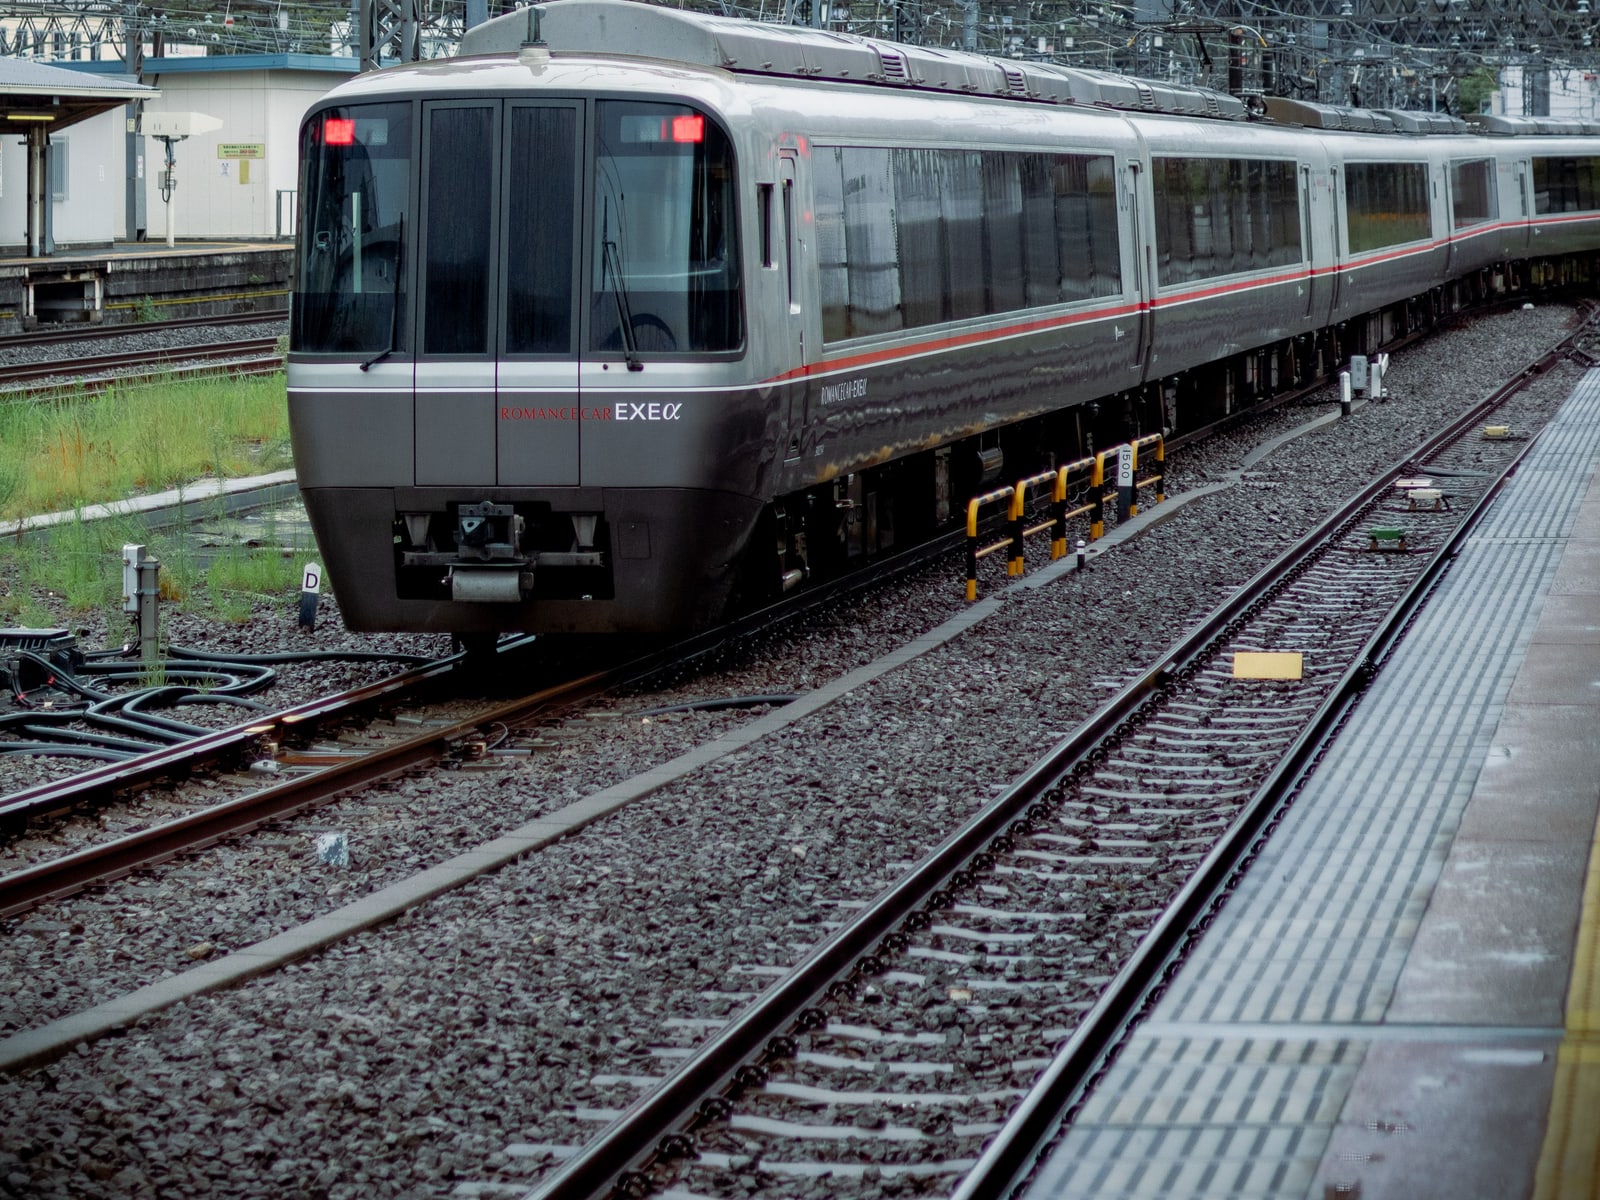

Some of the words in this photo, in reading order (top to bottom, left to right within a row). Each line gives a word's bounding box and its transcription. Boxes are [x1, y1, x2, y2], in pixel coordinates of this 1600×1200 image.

[501, 407, 612, 421] ROMANCECAR
[615, 402, 683, 421] EXEα
[1121, 449, 1132, 479] 1500
[305, 572, 319, 589] D
